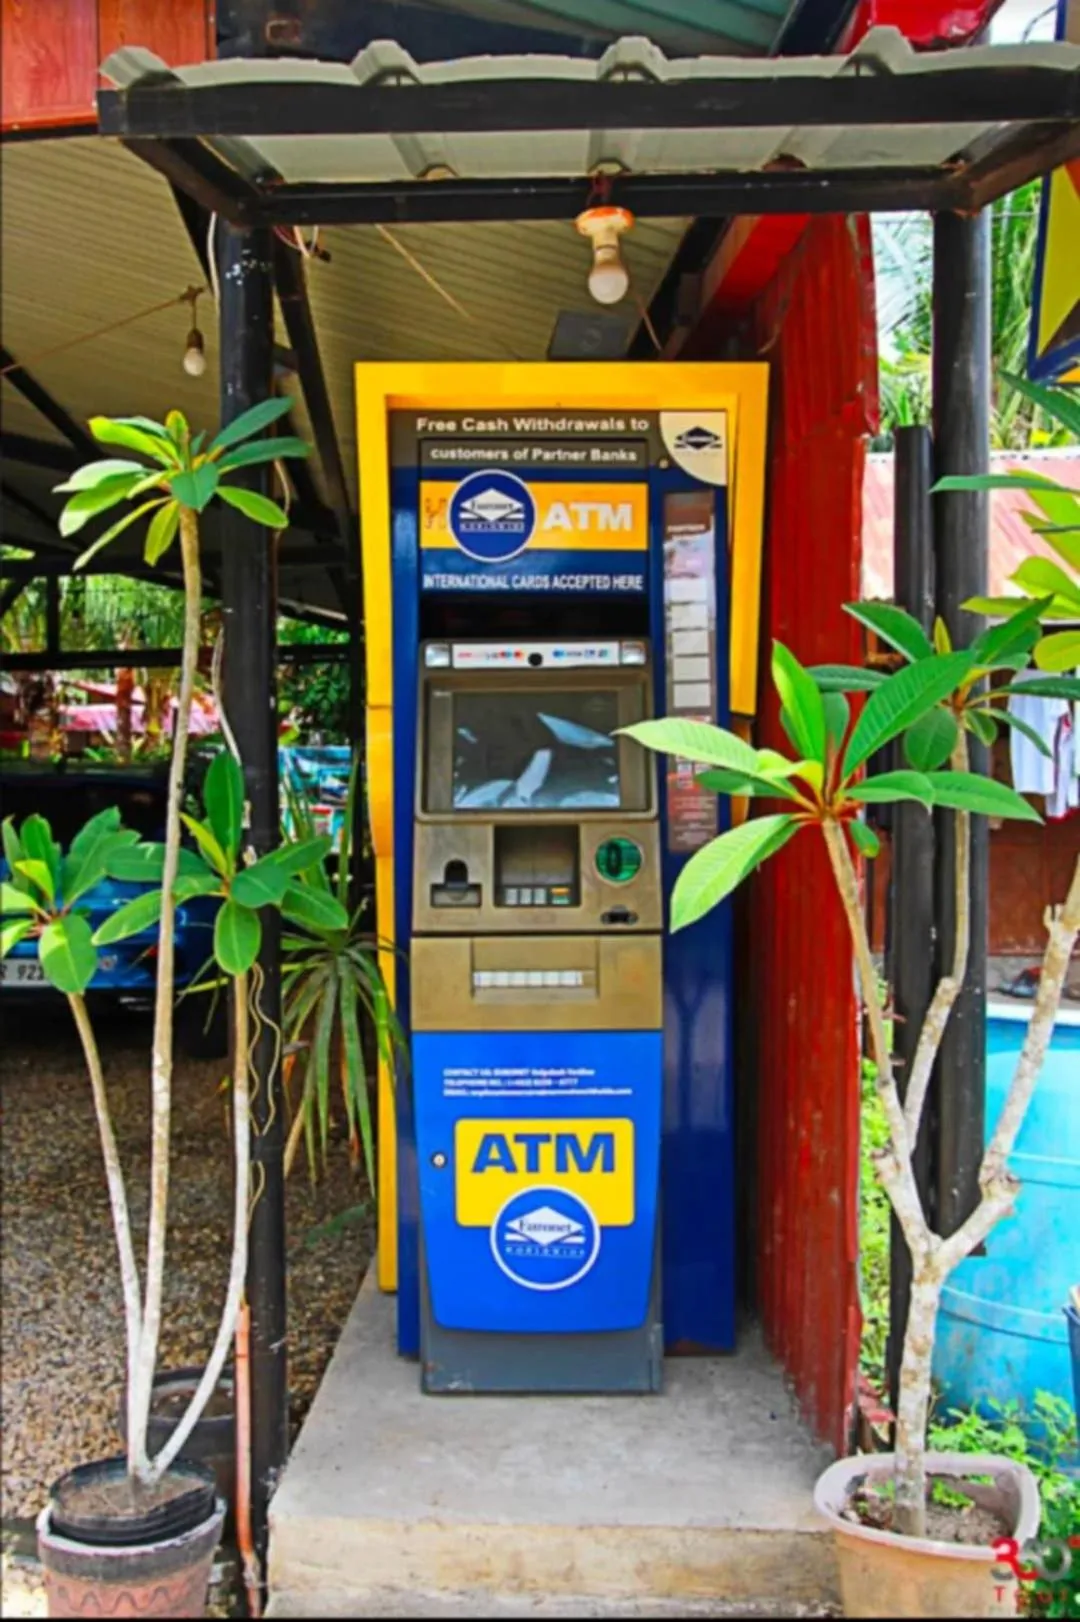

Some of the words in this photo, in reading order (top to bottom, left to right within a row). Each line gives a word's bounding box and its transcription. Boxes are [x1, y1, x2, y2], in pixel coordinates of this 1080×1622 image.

[416, 417, 457, 432] Free
[462, 417, 509, 432] Cash
[513, 417, 626, 432] Withdrawals
[630, 417, 649, 432] to
[431, 447, 509, 461] customers
[513, 447, 529, 460] of
[532, 448, 587, 461] Partner
[590, 448, 638, 462] Banks
[543, 502, 632, 531] ATM
[423, 574, 509, 590] INTERNATIONAL
[511, 574, 550, 590] CARDS
[551, 574, 611, 590] ACCEPTED
[613, 573, 643, 590] HERE
[472, 1133, 615, 1173] ATM
